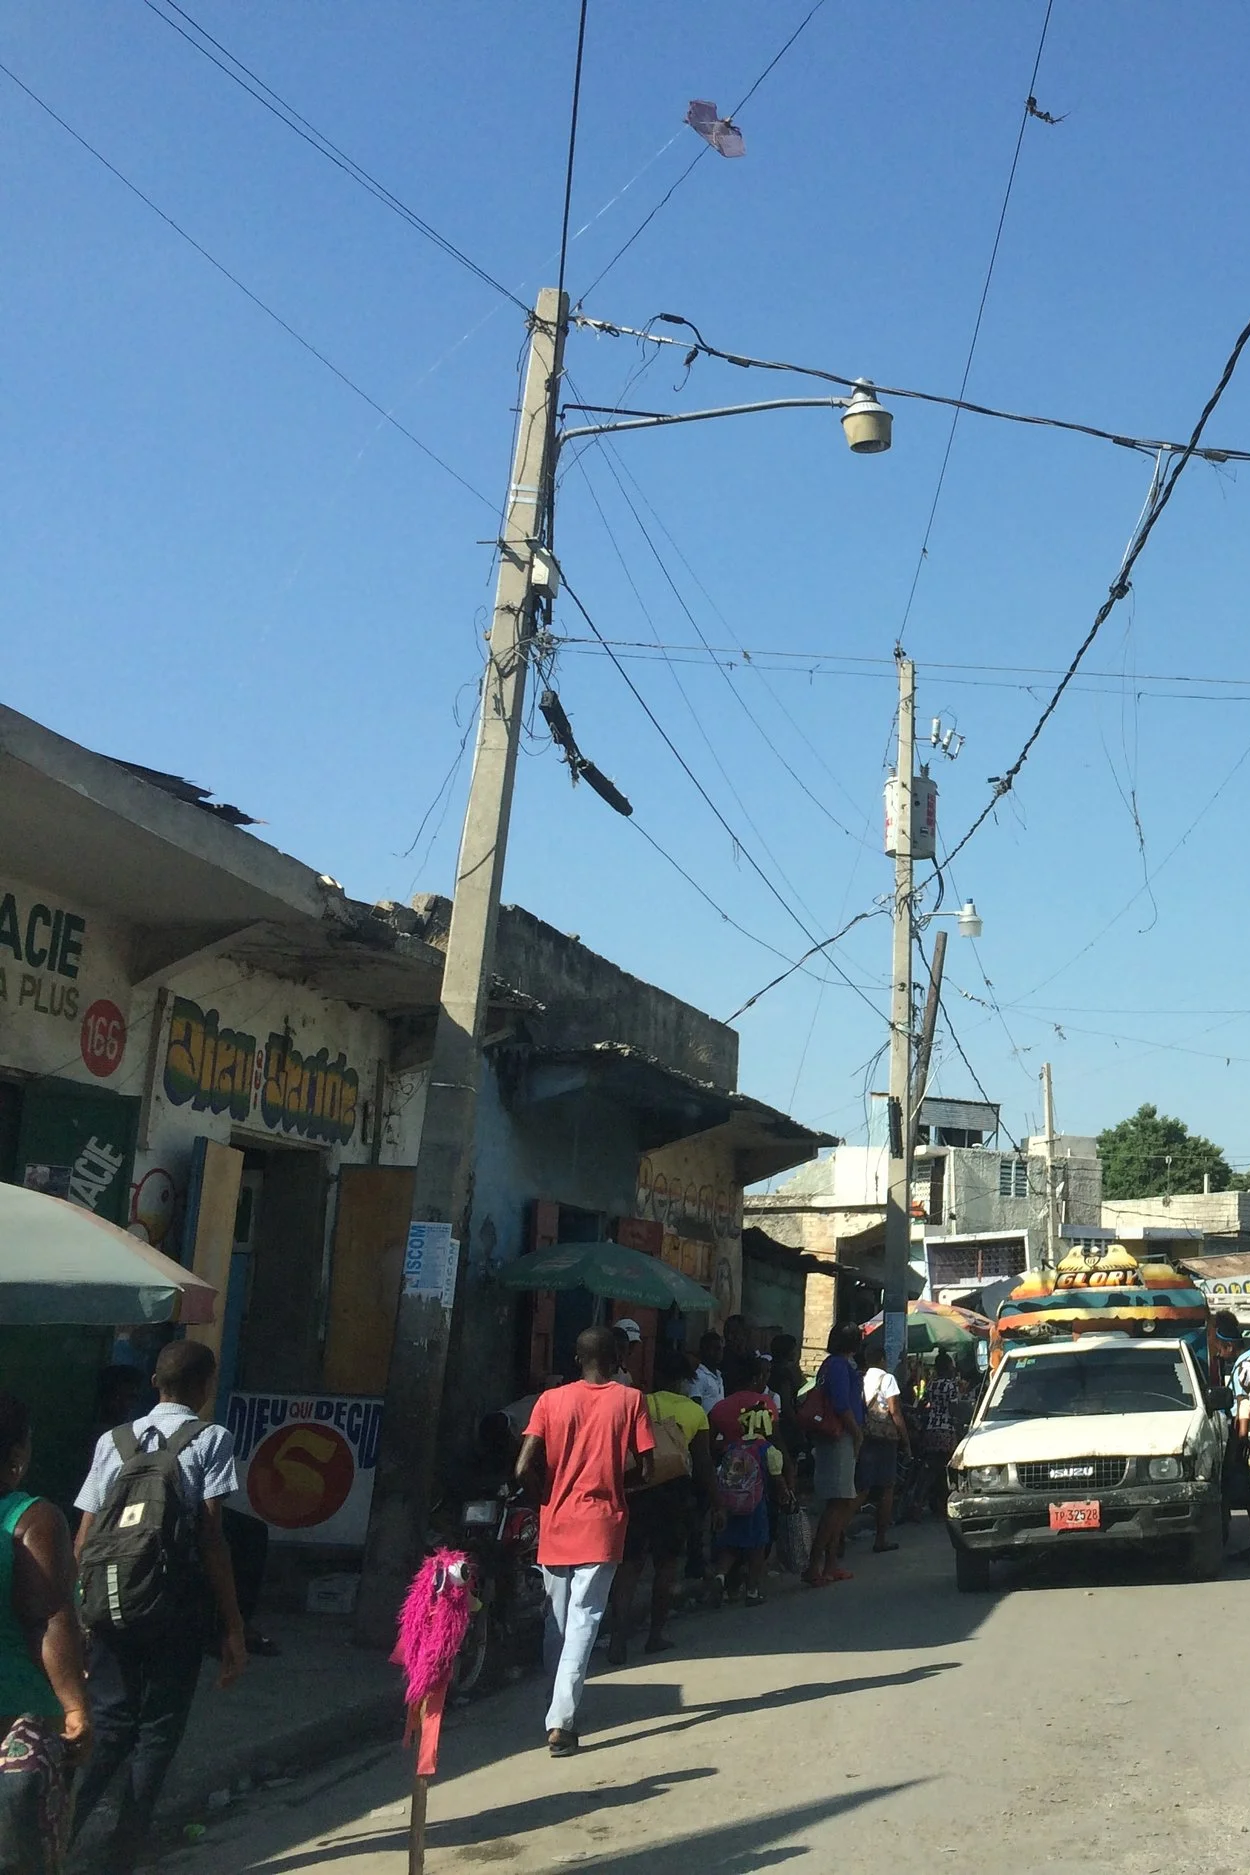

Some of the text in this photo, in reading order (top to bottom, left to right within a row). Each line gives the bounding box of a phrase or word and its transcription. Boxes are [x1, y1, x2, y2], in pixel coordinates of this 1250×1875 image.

[18, 973, 80, 1021] PLUS
[1056, 1269, 1138, 1289] GLORY
[226, 1396, 288, 1461] DIEU
[290, 1402, 314, 1419] QUI
[1049, 1466, 1094, 1479] ISUZU
[1067, 1509, 1098, 1521] 32528
